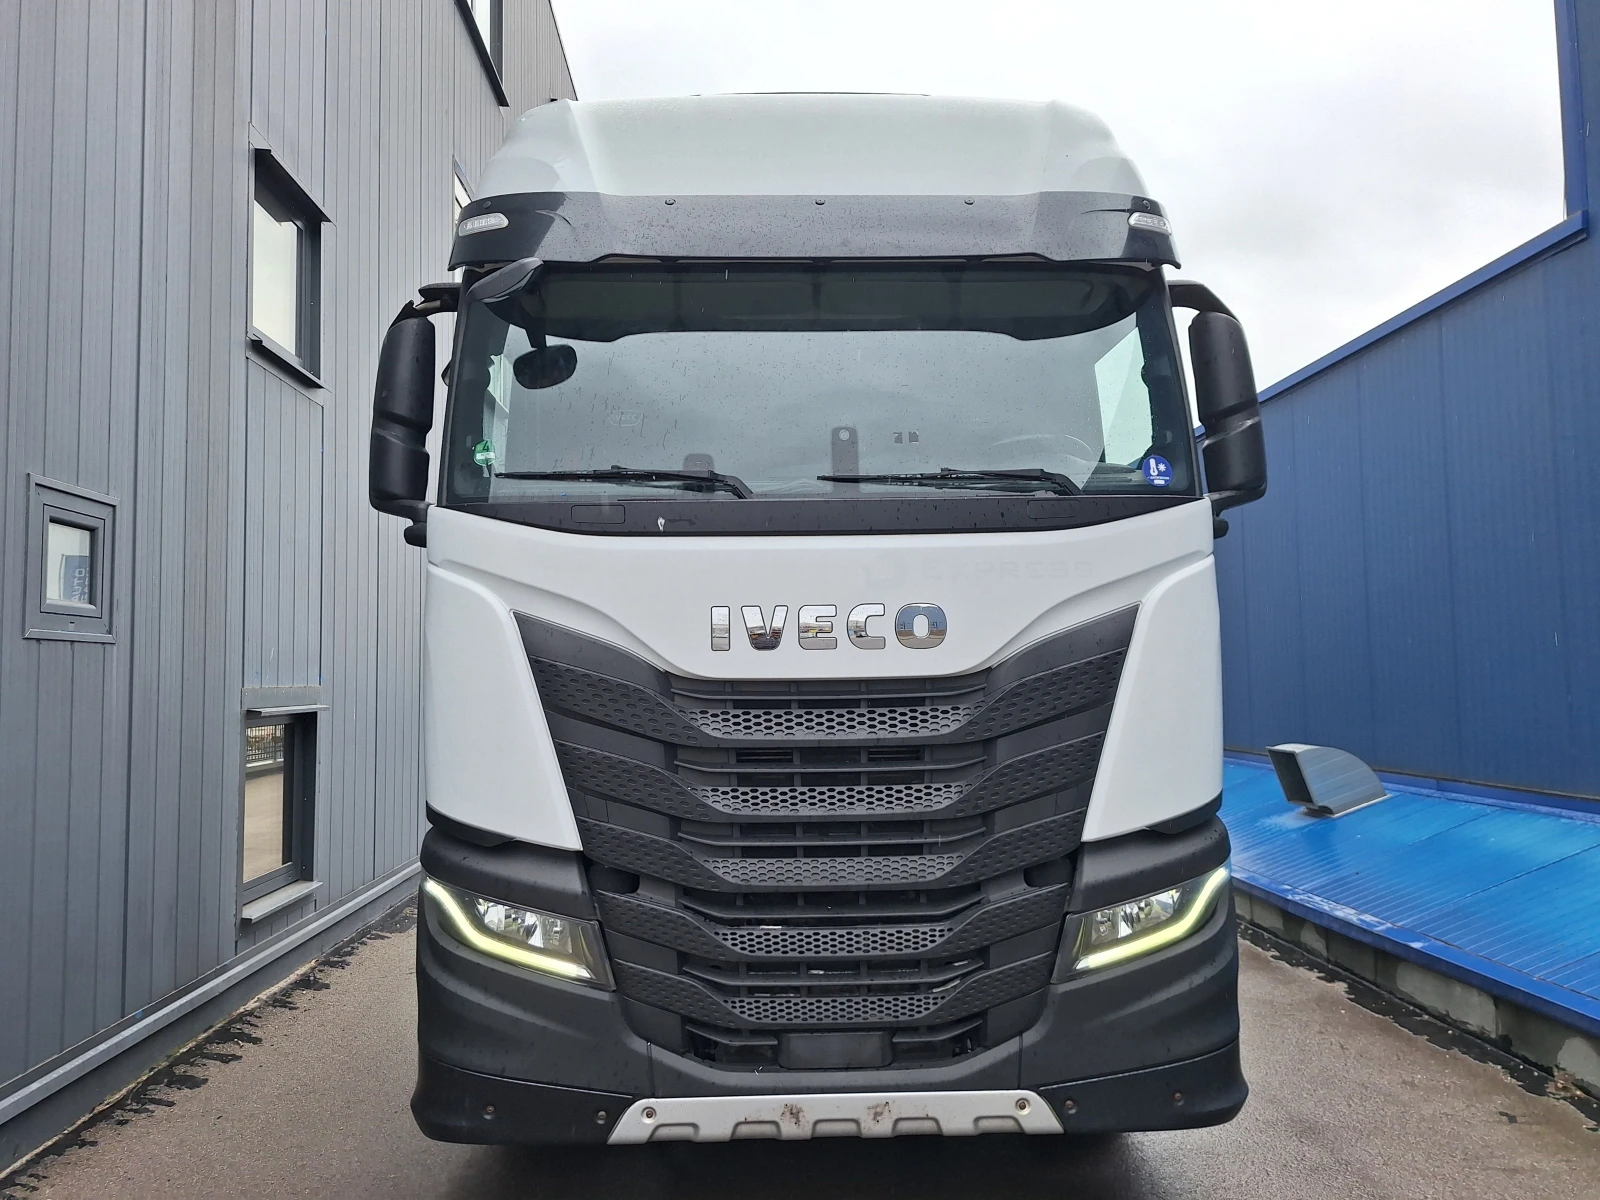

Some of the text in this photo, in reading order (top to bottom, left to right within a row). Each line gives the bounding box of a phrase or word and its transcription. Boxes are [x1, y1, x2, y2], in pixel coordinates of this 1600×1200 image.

[482, 440, 491, 452] 4
[72, 568, 85, 601] AUTO
[710, 602, 948, 651] IVECO
